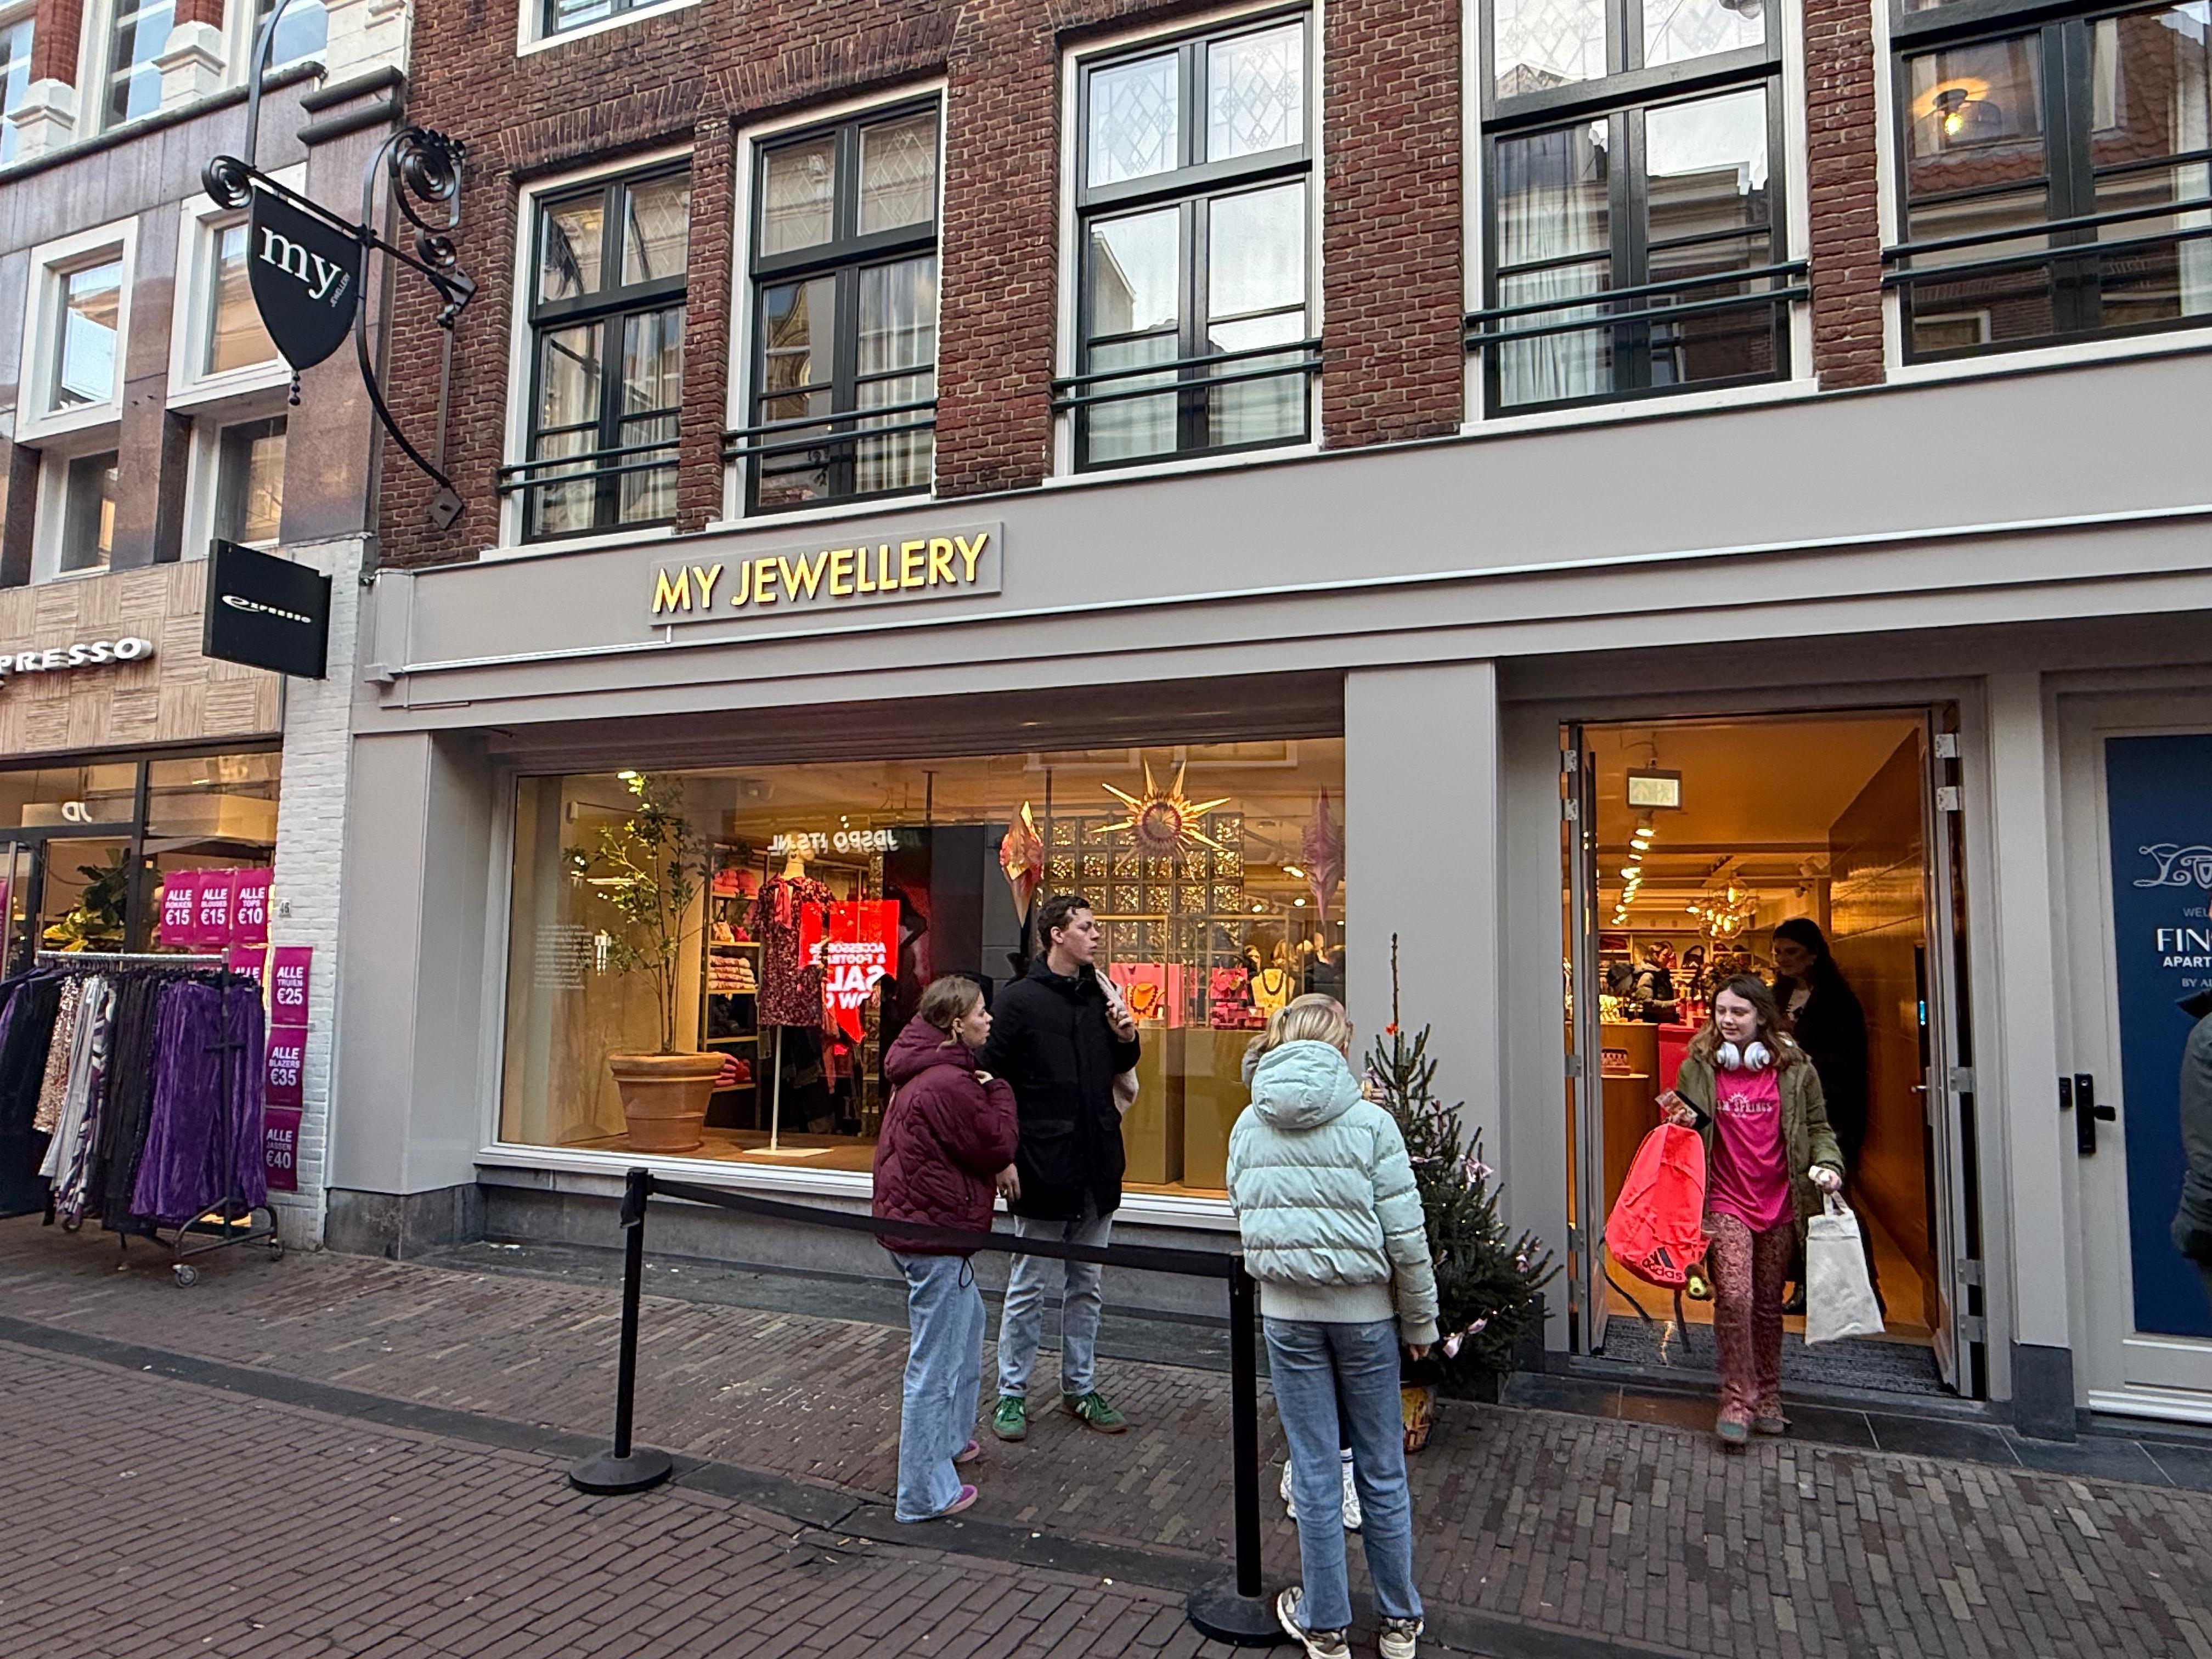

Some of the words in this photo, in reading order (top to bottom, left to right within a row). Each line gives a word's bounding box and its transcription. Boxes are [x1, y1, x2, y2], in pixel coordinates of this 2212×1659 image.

[259, 226, 342, 300] my
[652, 564, 724, 613] MY
[730, 532, 989, 607] JEWELLERY
[166, 889, 193, 901] ALLE
[202, 888, 228, 900] ALLE
[239, 887, 266, 900] ALLE
[165, 909, 190, 926] €15
[200, 908, 226, 926] €15
[237, 907, 264, 925] €10
[276, 966, 304, 979] ALLE
[2181, 978, 2197, 988] BY
[276, 988, 303, 1005] €25
[272, 1046, 300, 1060] ALLE
[270, 1068, 297, 1086] €35
[266, 1128, 293, 1143] ALLE
[266, 1149, 292, 1170] €40
